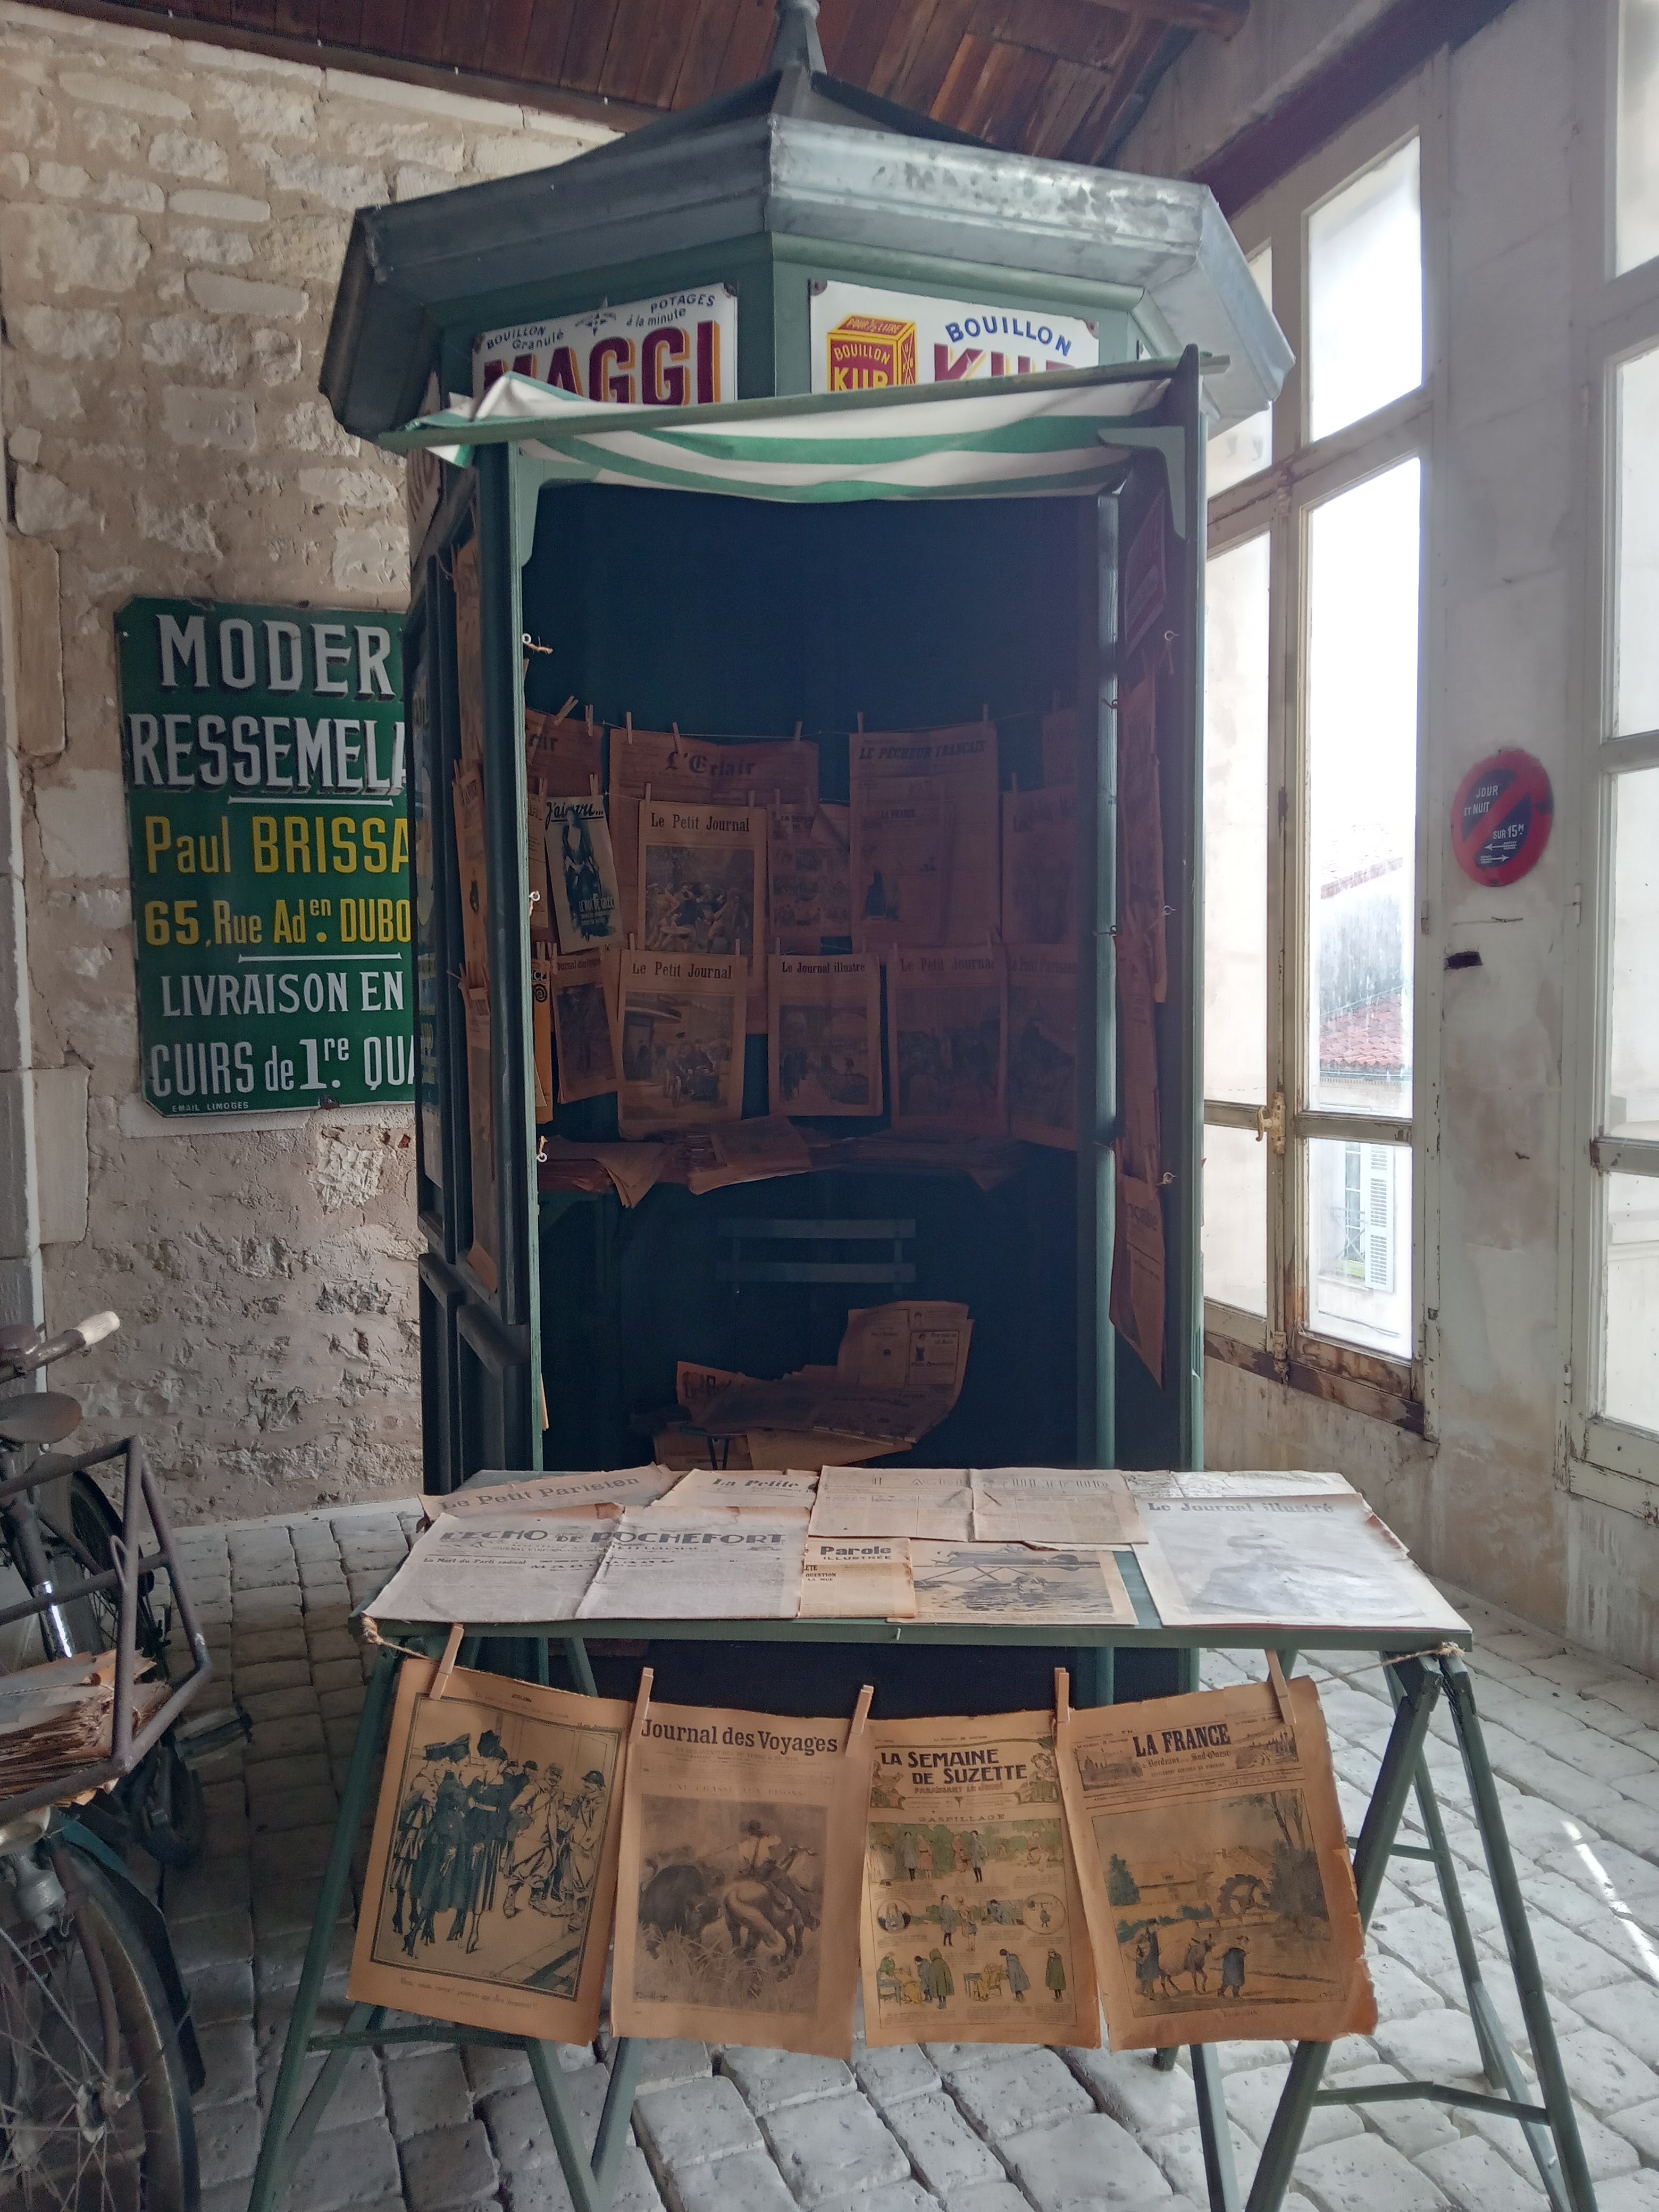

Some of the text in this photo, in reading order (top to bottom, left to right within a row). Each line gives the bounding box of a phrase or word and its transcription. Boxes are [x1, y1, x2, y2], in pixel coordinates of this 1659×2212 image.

[486, 294, 716, 350] BOUILLON POTAGES
[647, 307, 686, 326] minute
[945, 315, 1072, 357] BOUILLON
[834, 343, 891, 365] BOUILLON
[156, 614, 397, 696] MODER
[859, 747, 874, 759] LE
[1476, 785, 1499, 798] JOUR
[1463, 801, 1490, 817] ET NUIT
[651, 813, 750, 832] Le Petit Journal
[145, 816, 230, 874] Paul
[1493, 830, 1506, 840] SUR
[214, 900, 262, 944] Rue
[632, 960, 732, 980] Le Petit Journal
[782, 961, 793, 973] Le
[797, 961, 831, 974] Journal
[900, 958, 914, 972] Le
[920, 957, 944, 971] Petit
[161, 971, 405, 1017] LIVRAISON EN
[150, 1041, 255, 1097] CUIRS
[265, 1045, 294, 1091] de
[172, 1102, 249, 1113] EMAIL LIMOGES
[438, 1477, 641, 1510] Le Petit Parisien
[1148, 1502, 1170, 1512] Le
[1182, 1502, 1255, 1513] Journal
[820, 1546, 892, 1555] Parole
[641, 1719, 839, 1756] Journal des Voyages
[1133, 1735, 1159, 1757] LA
[1161, 1723, 1231, 1755] FRANCE
[881, 1748, 999, 1769] LA SEMAINE
[912, 1764, 1027, 1785] DE SUZETTE
[919, 1814, 1005, 1822] GASPILLAGE
